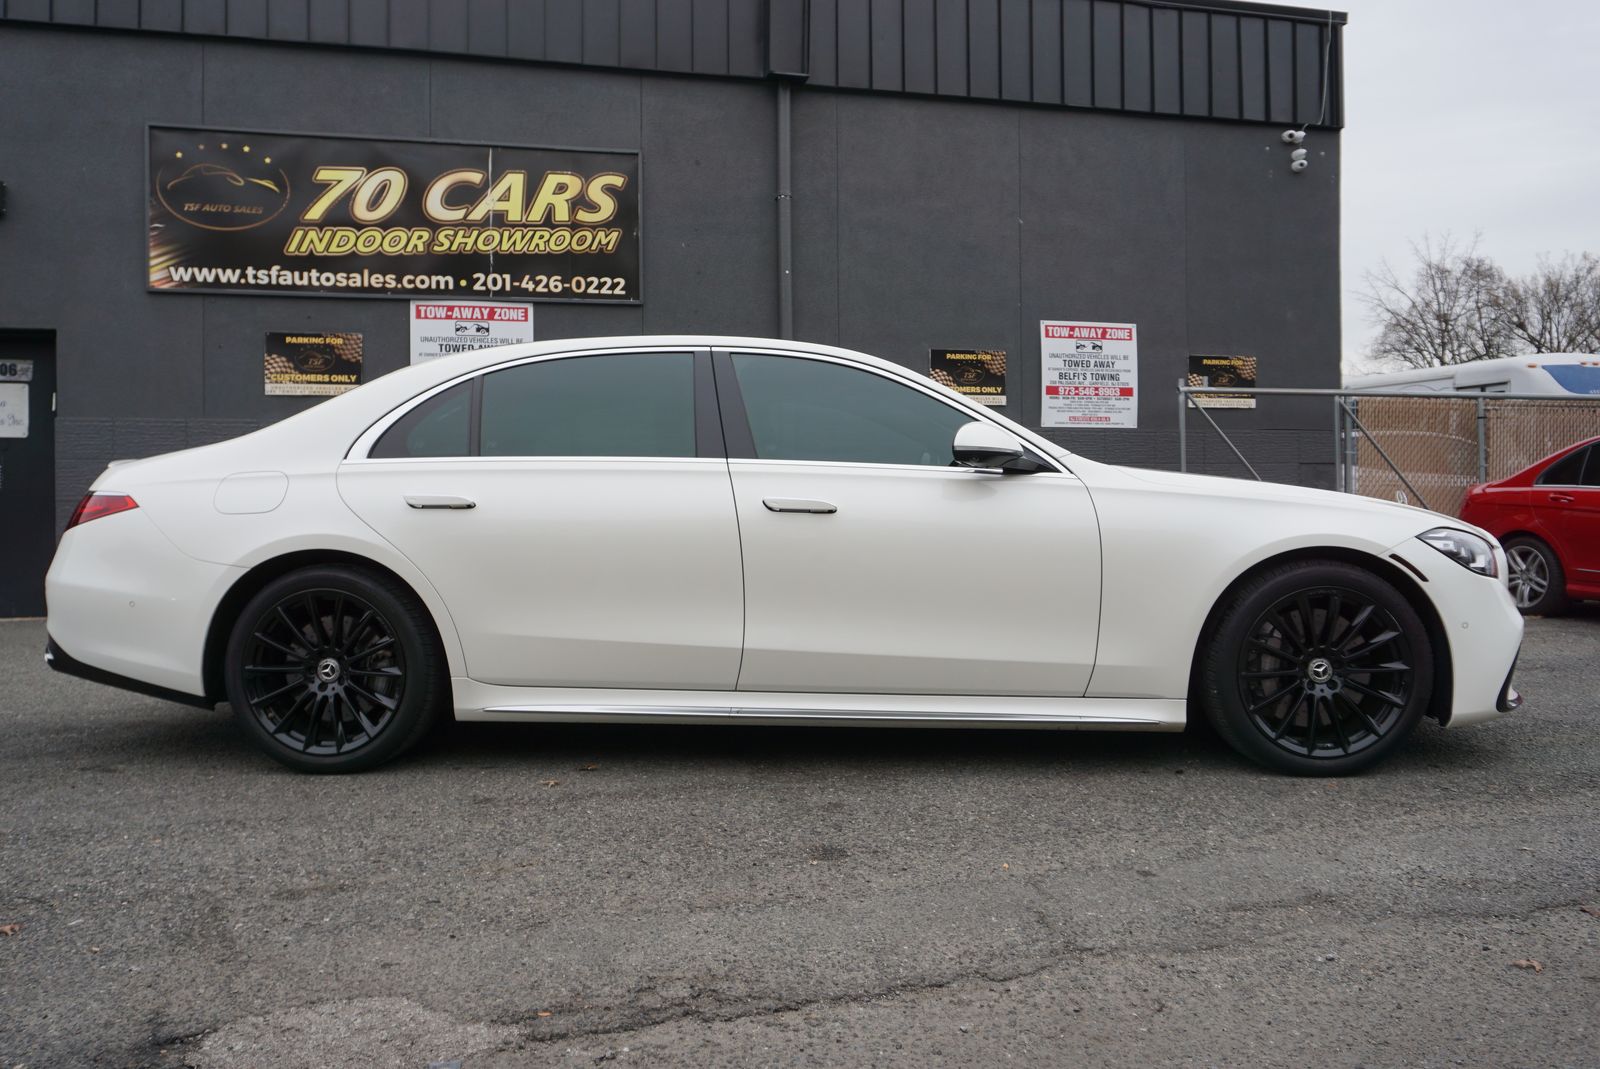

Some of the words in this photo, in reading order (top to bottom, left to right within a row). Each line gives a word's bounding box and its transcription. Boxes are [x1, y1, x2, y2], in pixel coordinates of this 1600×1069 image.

[302, 166, 408, 224] 70
[422, 168, 628, 225] CARS
[183, 203, 202, 211] TSF
[202, 204, 231, 212] AUTO
[233, 205, 264, 214] SALES
[284, 227, 432, 256] INDOOR
[431, 226, 622, 255] SHOWROOM
[168, 265, 454, 290] www.tsfautosales.com
[472, 272, 626, 295] 201-426-0222
[418, 306, 490, 320] TOW-AWAY
[493, 308, 525, 321] ZONE
[1047, 326, 1103, 338] TOW-AWAY
[1105, 328, 1131, 339] ZONE
[285, 336, 324, 344] PARKING
[325, 337, 343, 345] FOR
[438, 344, 475, 353] TOWED
[1062, 359, 1091, 368] TOWED
[1093, 360, 1116, 368] AWAY
[271, 374, 330, 382] CUSTOMERS
[1058, 372, 1087, 380] BELFI'S
[1091, 373, 1120, 381] TOWING
[1058, 387, 1121, 395] 973-546-8903
